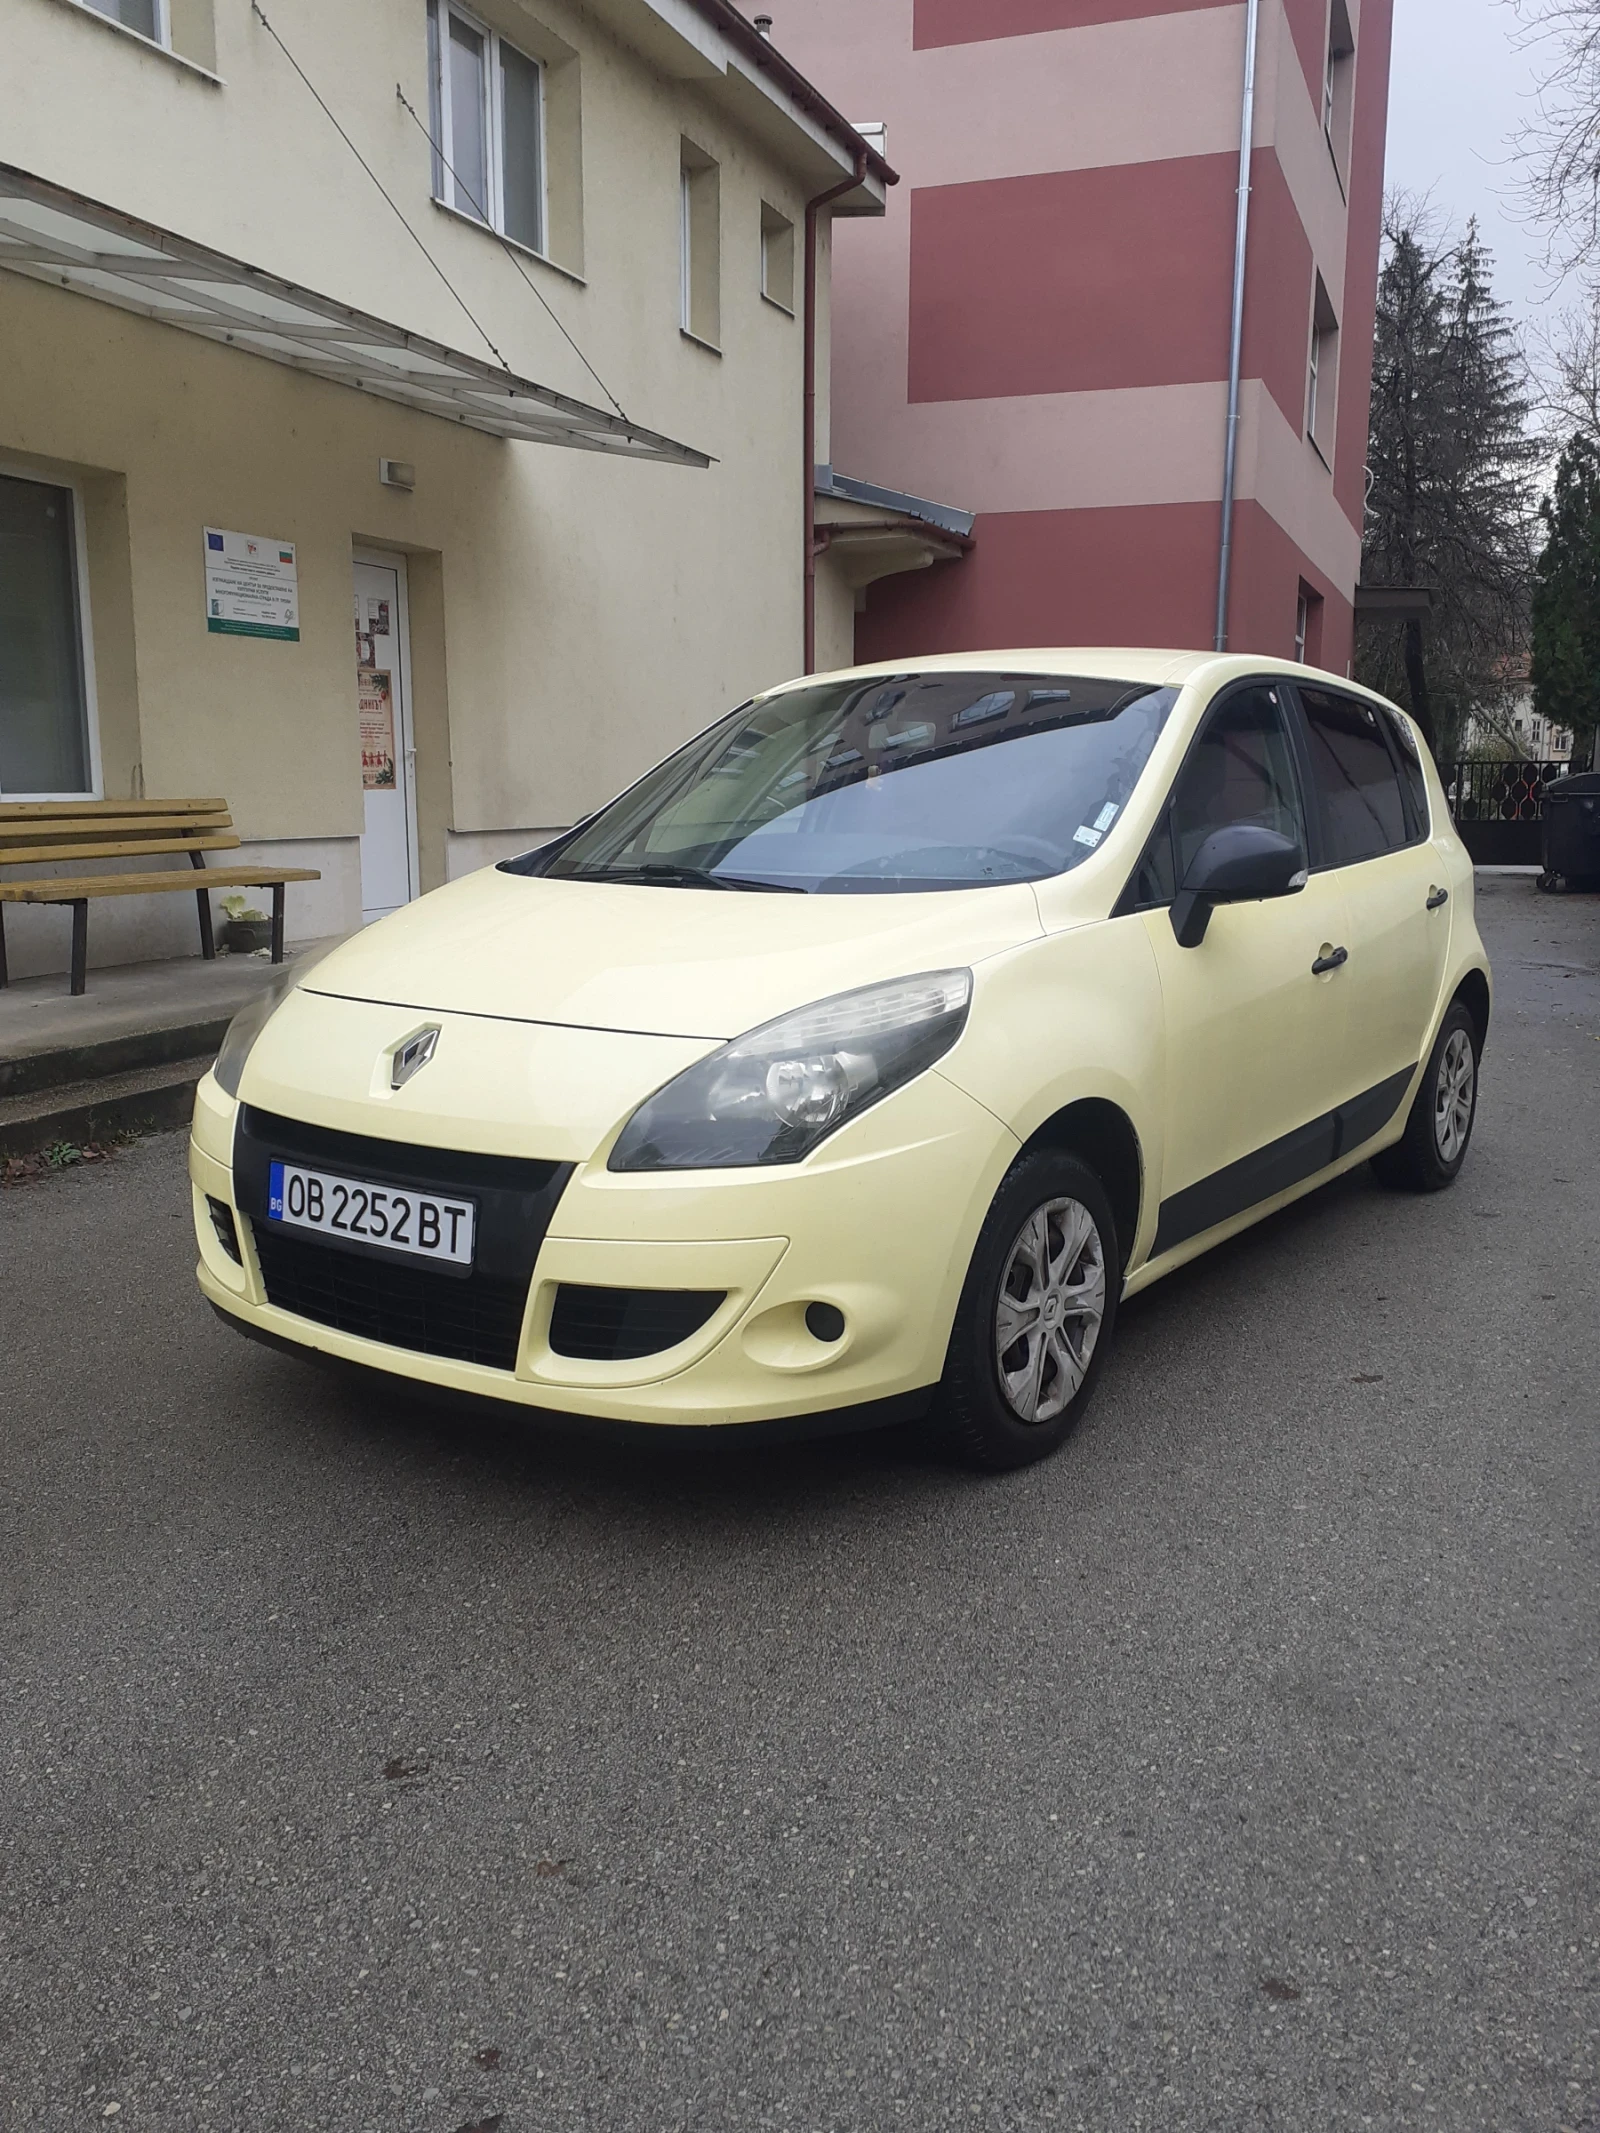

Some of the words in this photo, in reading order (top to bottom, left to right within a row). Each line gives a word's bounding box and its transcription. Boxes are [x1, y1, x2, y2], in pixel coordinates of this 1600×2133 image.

[270, 1197, 282, 1212] BG
[288, 1174, 325, 1222] OB
[331, 1184, 411, 1245] 2252
[418, 1201, 467, 1254] BT
